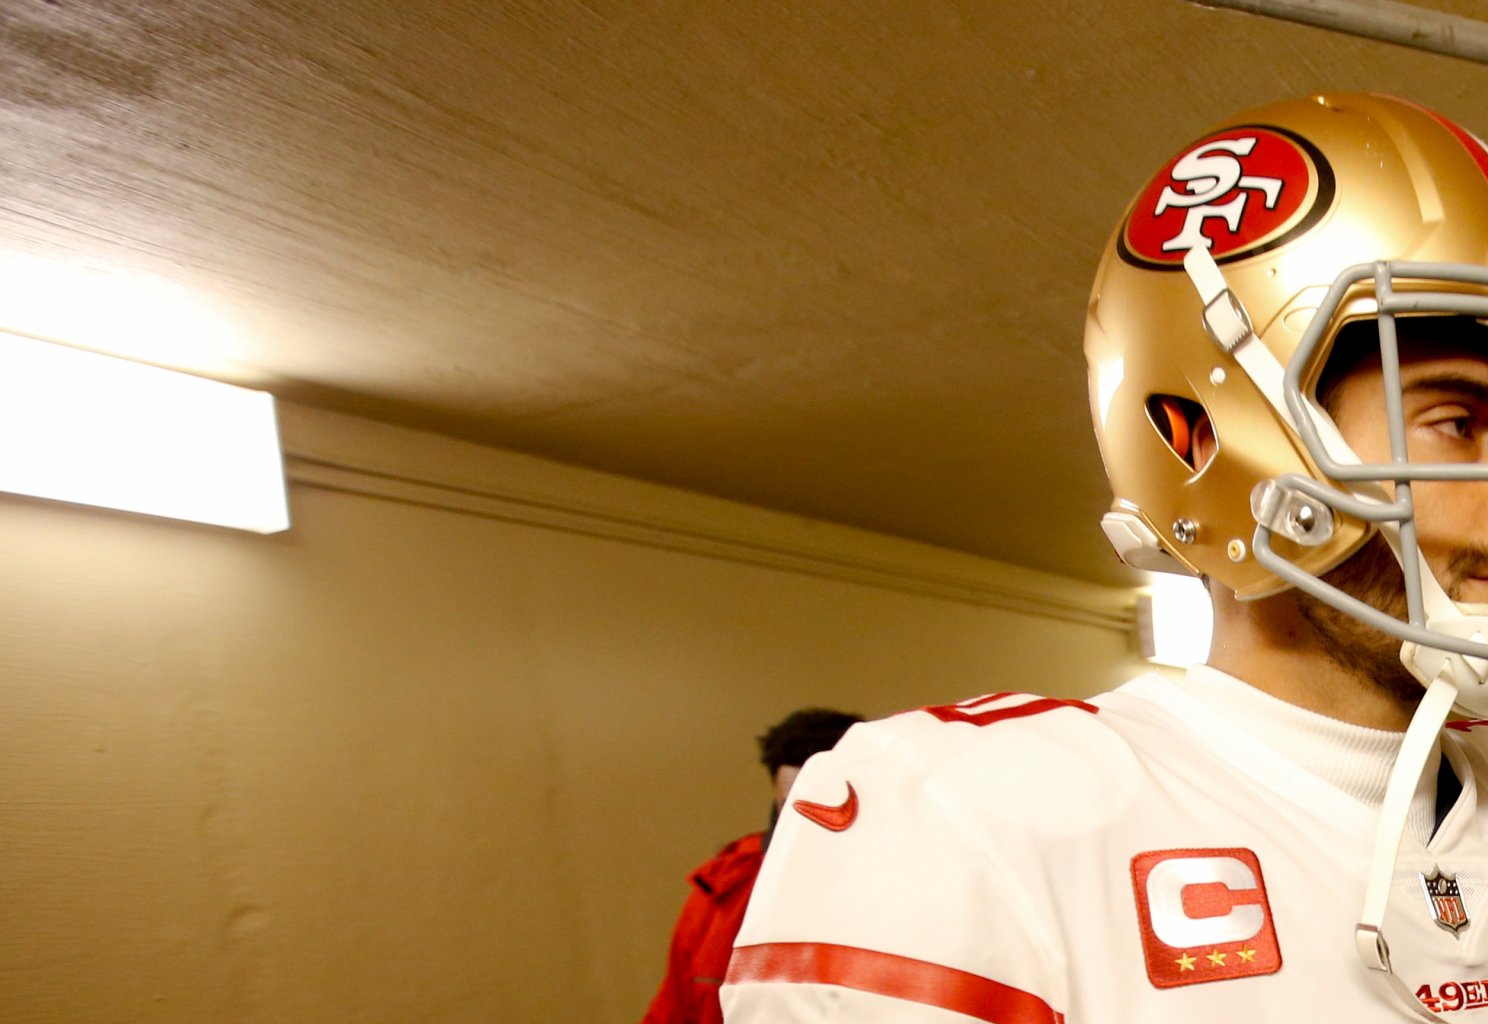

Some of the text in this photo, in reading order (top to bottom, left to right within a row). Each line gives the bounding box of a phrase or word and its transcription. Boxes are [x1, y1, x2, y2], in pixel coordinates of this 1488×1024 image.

[1154, 136, 1283, 252] SF
[1145, 856, 1265, 949] C
[1432, 896, 1467, 925] NFL
